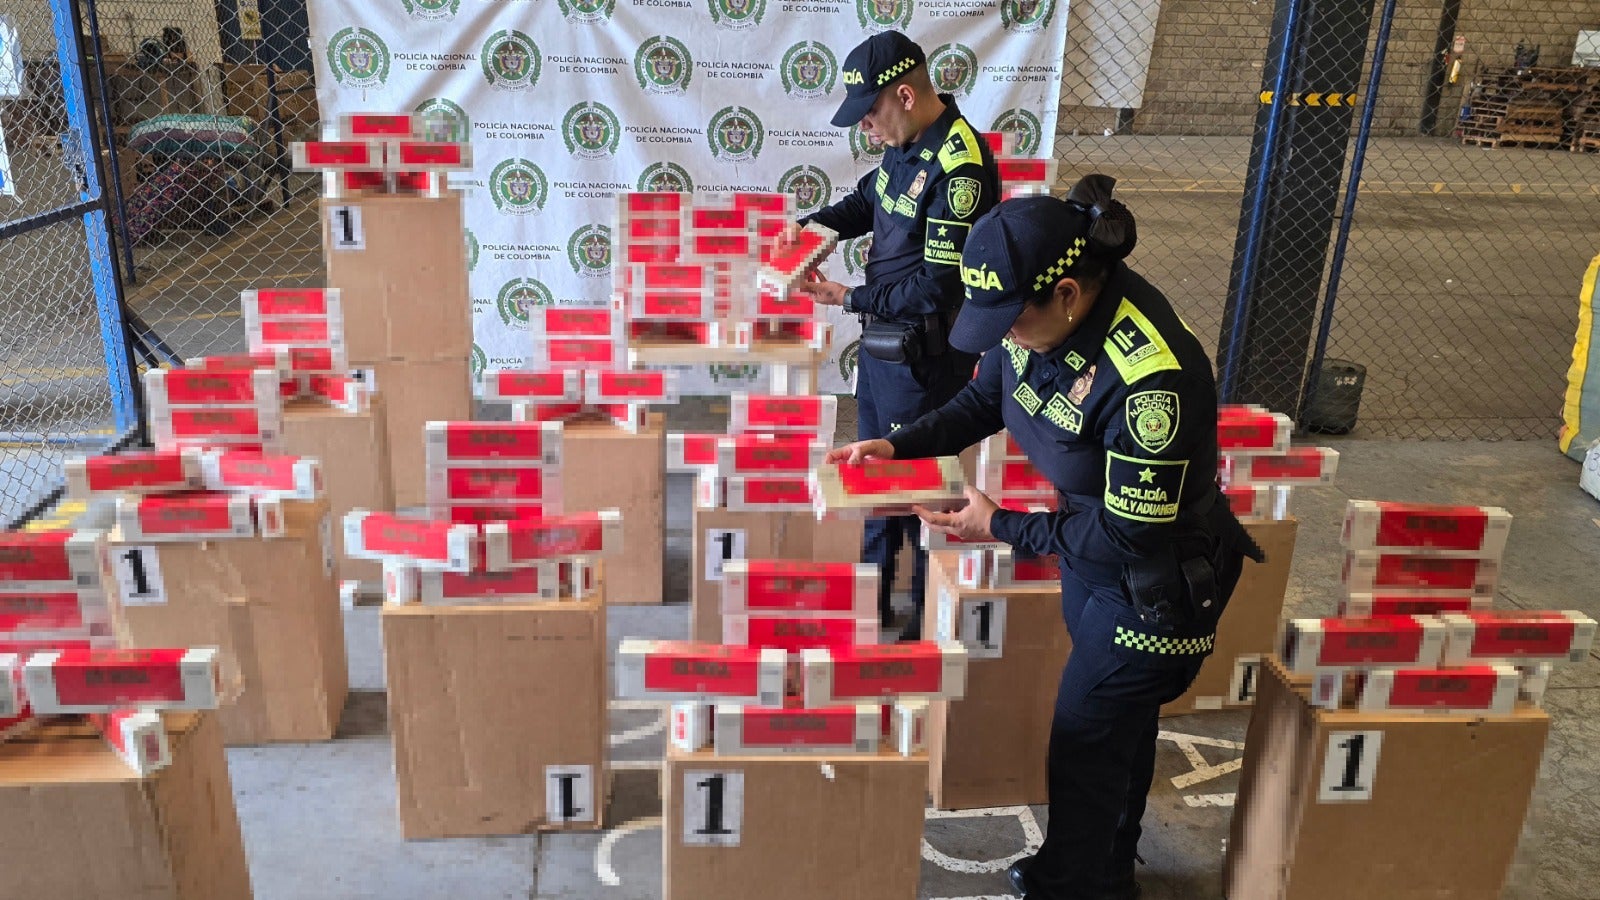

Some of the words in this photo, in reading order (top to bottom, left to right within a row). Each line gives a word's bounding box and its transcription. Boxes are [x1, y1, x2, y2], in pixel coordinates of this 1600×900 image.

[647, 0, 692, 8] COLOMBIA
[918, 0, 951, 8] POLICÍA
[548, 55, 582, 63] POLICÍA
[584, 56, 629, 65] NACIONAL
[696, 60, 730, 69] POLICÍA
[732, 62, 775, 70] NACIONAL
[573, 66, 618, 74] COLOMBIA
[982, 65, 1015, 73] POLICÍA
[720, 71, 764, 79] COLOMBIA
[510, 123, 556, 131] NACIONAL
[500, 132, 545, 140] COLOMBIA
[768, 129, 800, 137] POLICÍA
[554, 181, 587, 189] POLICÍA
[336, 207, 358, 245] 1
[928, 240, 954, 250] POLICÍA
[1134, 394, 1171, 406] POLICÍA
[1130, 402, 1175, 418] NACIONAL
[1120, 485, 1168, 502] POLICÍA
[1130, 500, 1138, 512] Y
[121, 549, 160, 597] 1
[972, 602, 998, 650] 1
[1329, 734, 1366, 791] 1
[697, 773, 733, 834] 1
